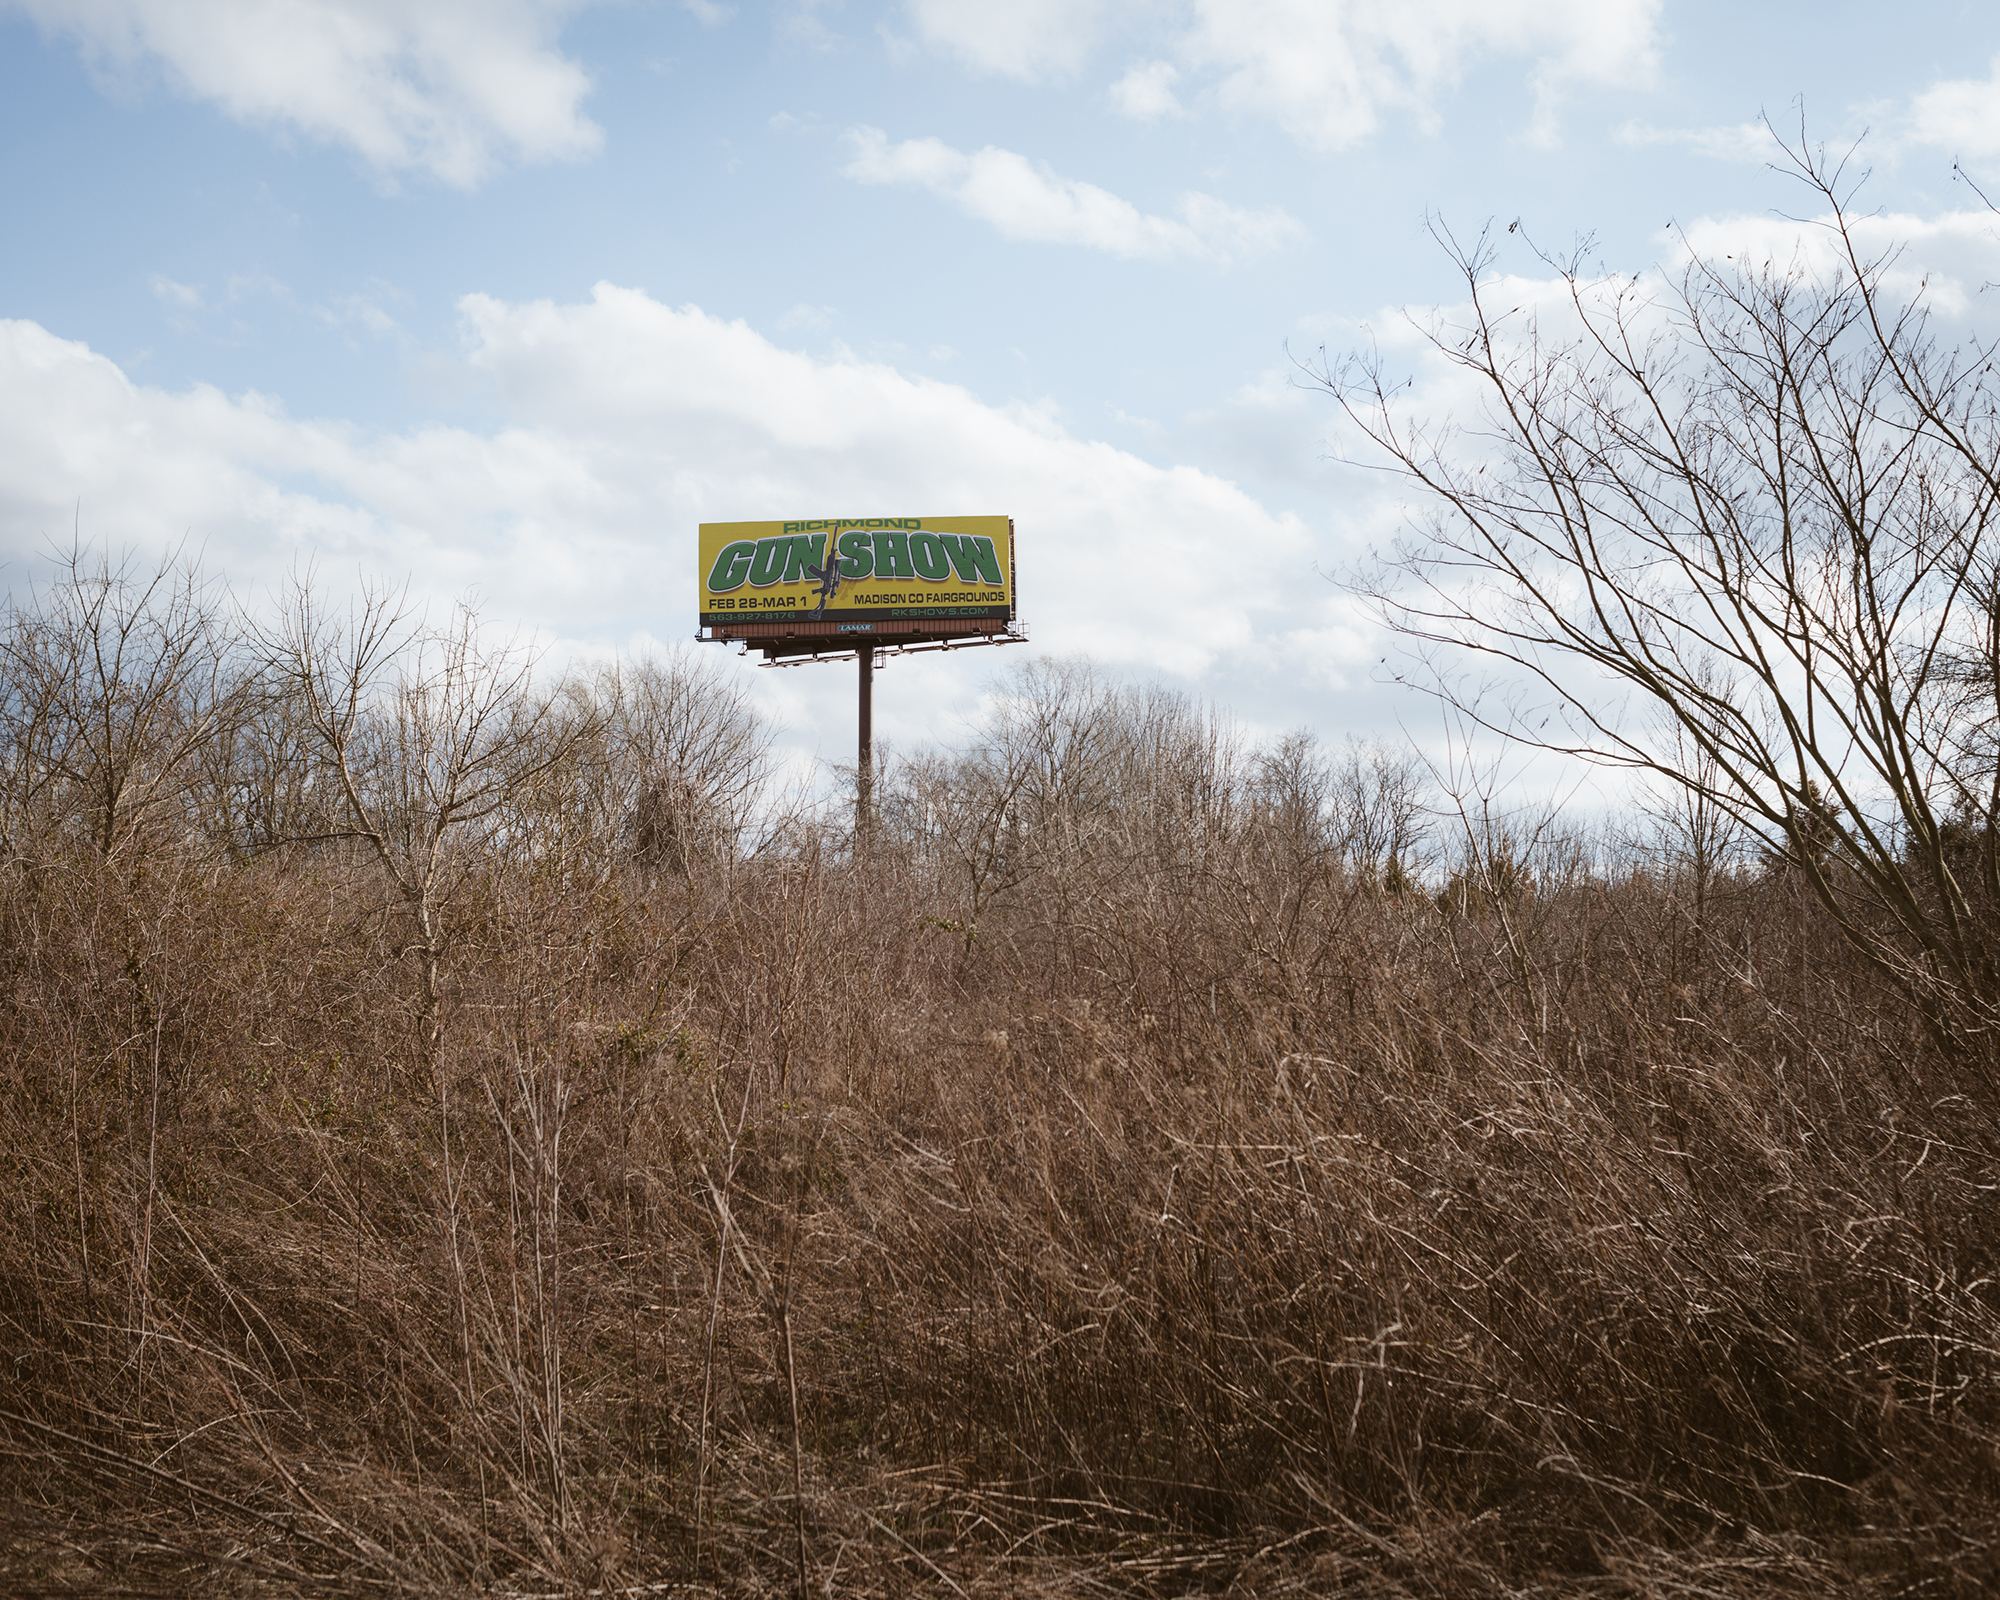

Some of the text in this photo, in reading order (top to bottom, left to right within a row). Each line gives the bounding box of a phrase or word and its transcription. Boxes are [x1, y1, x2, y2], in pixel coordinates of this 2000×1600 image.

[783, 518, 921, 534] RICHMOND
[707, 531, 1004, 592] GUN SHOW
[709, 596, 807, 609] FEB 28-MAR 1
[854, 591, 1005, 605] MADISON CO FAIRGROUNDS
[708, 612, 796, 621] 563-927-8176
[891, 607, 989, 617] RKSHOWS.COM
